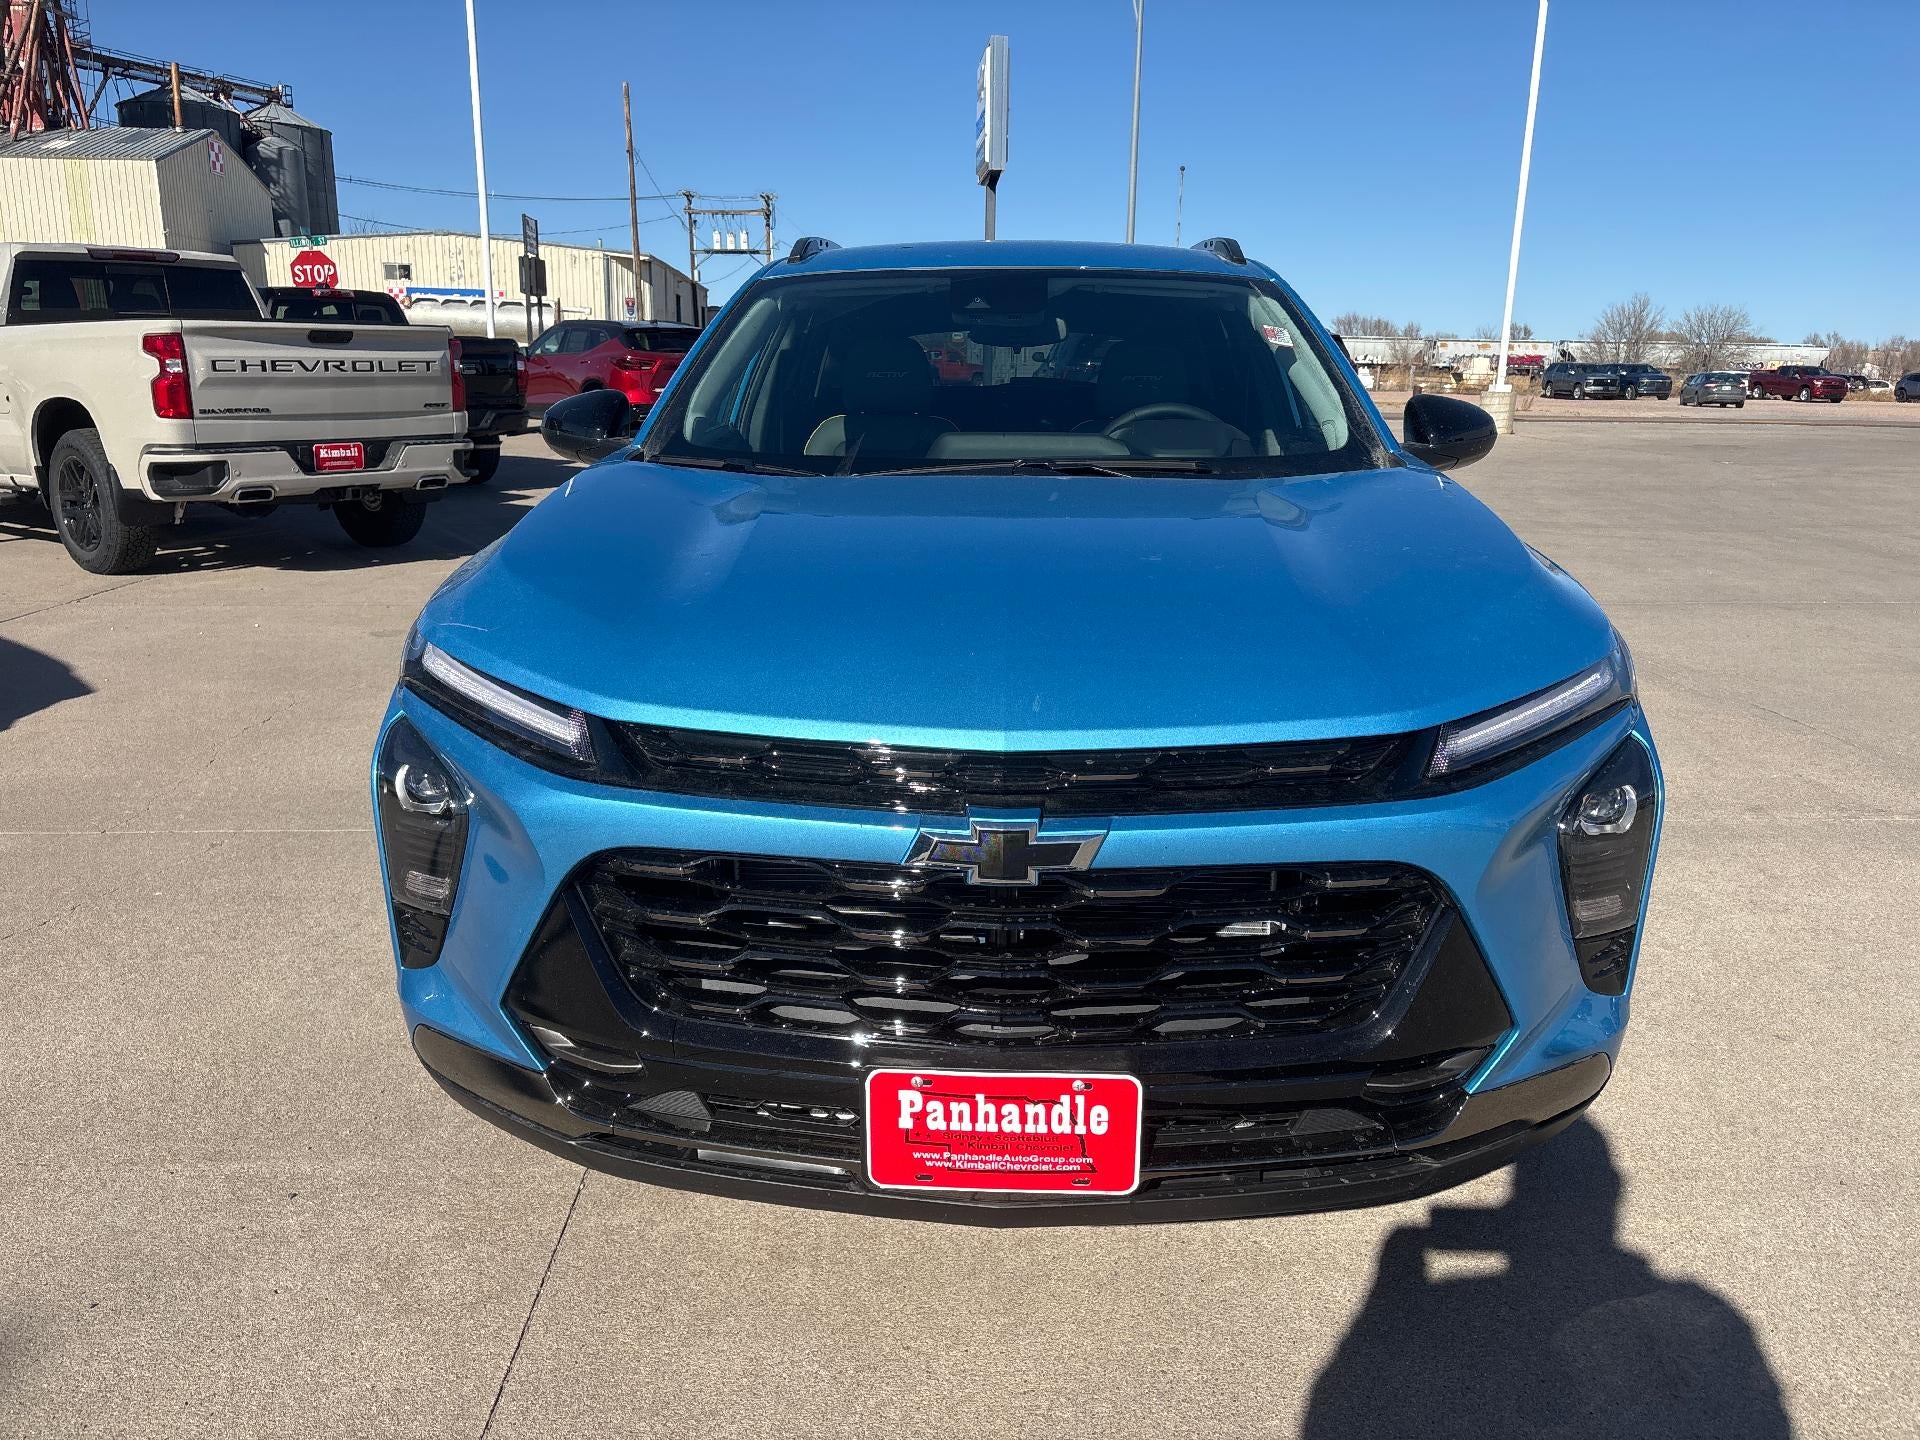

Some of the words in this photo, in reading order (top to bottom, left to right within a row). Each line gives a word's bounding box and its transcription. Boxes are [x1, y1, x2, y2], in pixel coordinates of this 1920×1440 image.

[293, 264, 335, 283] STOP
[211, 359, 438, 373] CHEVROLET
[198, 407, 272, 416] SILVERADO
[319, 447, 359, 458] Kimball
[897, 1089, 1109, 1135] Panhandle
[942, 1131, 982, 1141] Sidney
[966, 1141, 1012, 1151] Kimball
[1016, 1143, 1074, 1152] Chevrolet
[912, 1151, 1093, 1164] www.PanhandleAutoGroup.com
[925, 1160, 1081, 1172] www.KimballChevrolet.com
